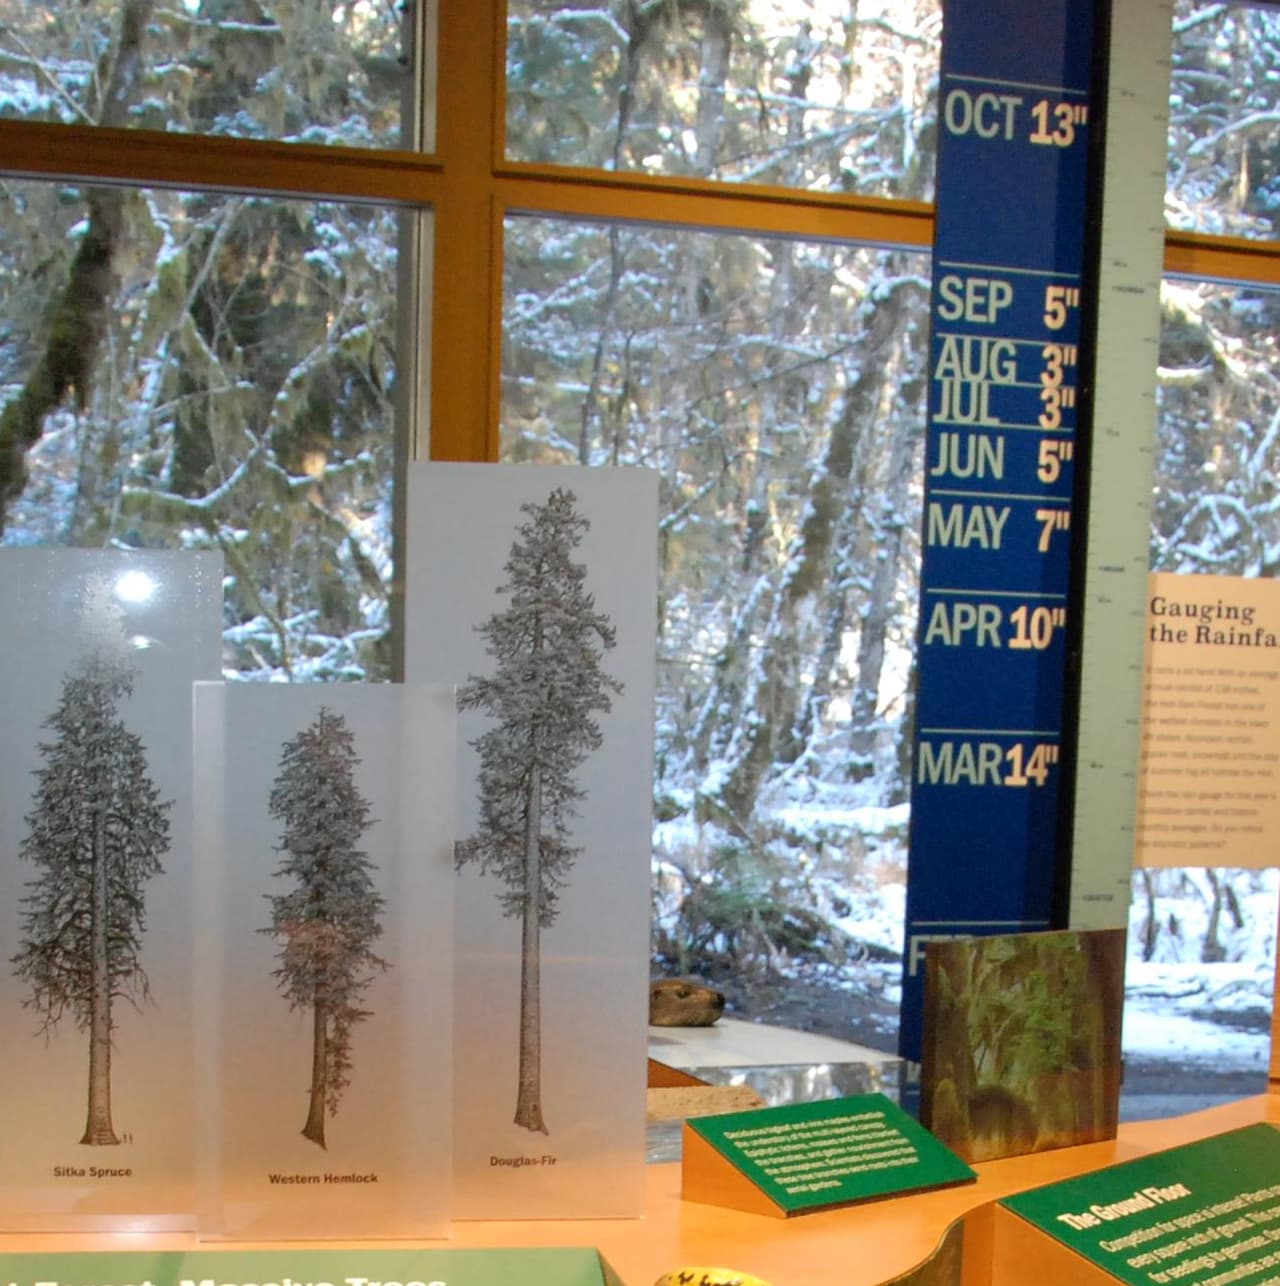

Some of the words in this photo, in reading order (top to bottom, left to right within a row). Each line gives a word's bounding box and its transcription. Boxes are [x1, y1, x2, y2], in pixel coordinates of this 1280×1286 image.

[945, 90, 1021, 141] OCT
[937, 275, 1013, 323] SEP
[933, 340, 1017, 383] AUG
[932, 380, 999, 425] JUL
[930, 432, 1004, 480] JUN
[928, 503, 1010, 550] MAY
[925, 603, 1001, 648] APR
[1149, 596, 1256, 625] Gauging
[1149, 625, 1188, 644] the
[918, 741, 1001, 785] MAR
[53, 1166, 86, 1177] Sitka
[89, 1166, 132, 1179] Spruce
[269, 1173, 320, 1184] Western
[324, 1172, 378, 1184] Hemlock
[489, 1156, 557, 1168] Douglas-Fir
[1055, 1212, 1101, 1230] The
[1089, 1191, 1154, 1220] Ground
[1141, 1182, 1190, 1204] Floor
